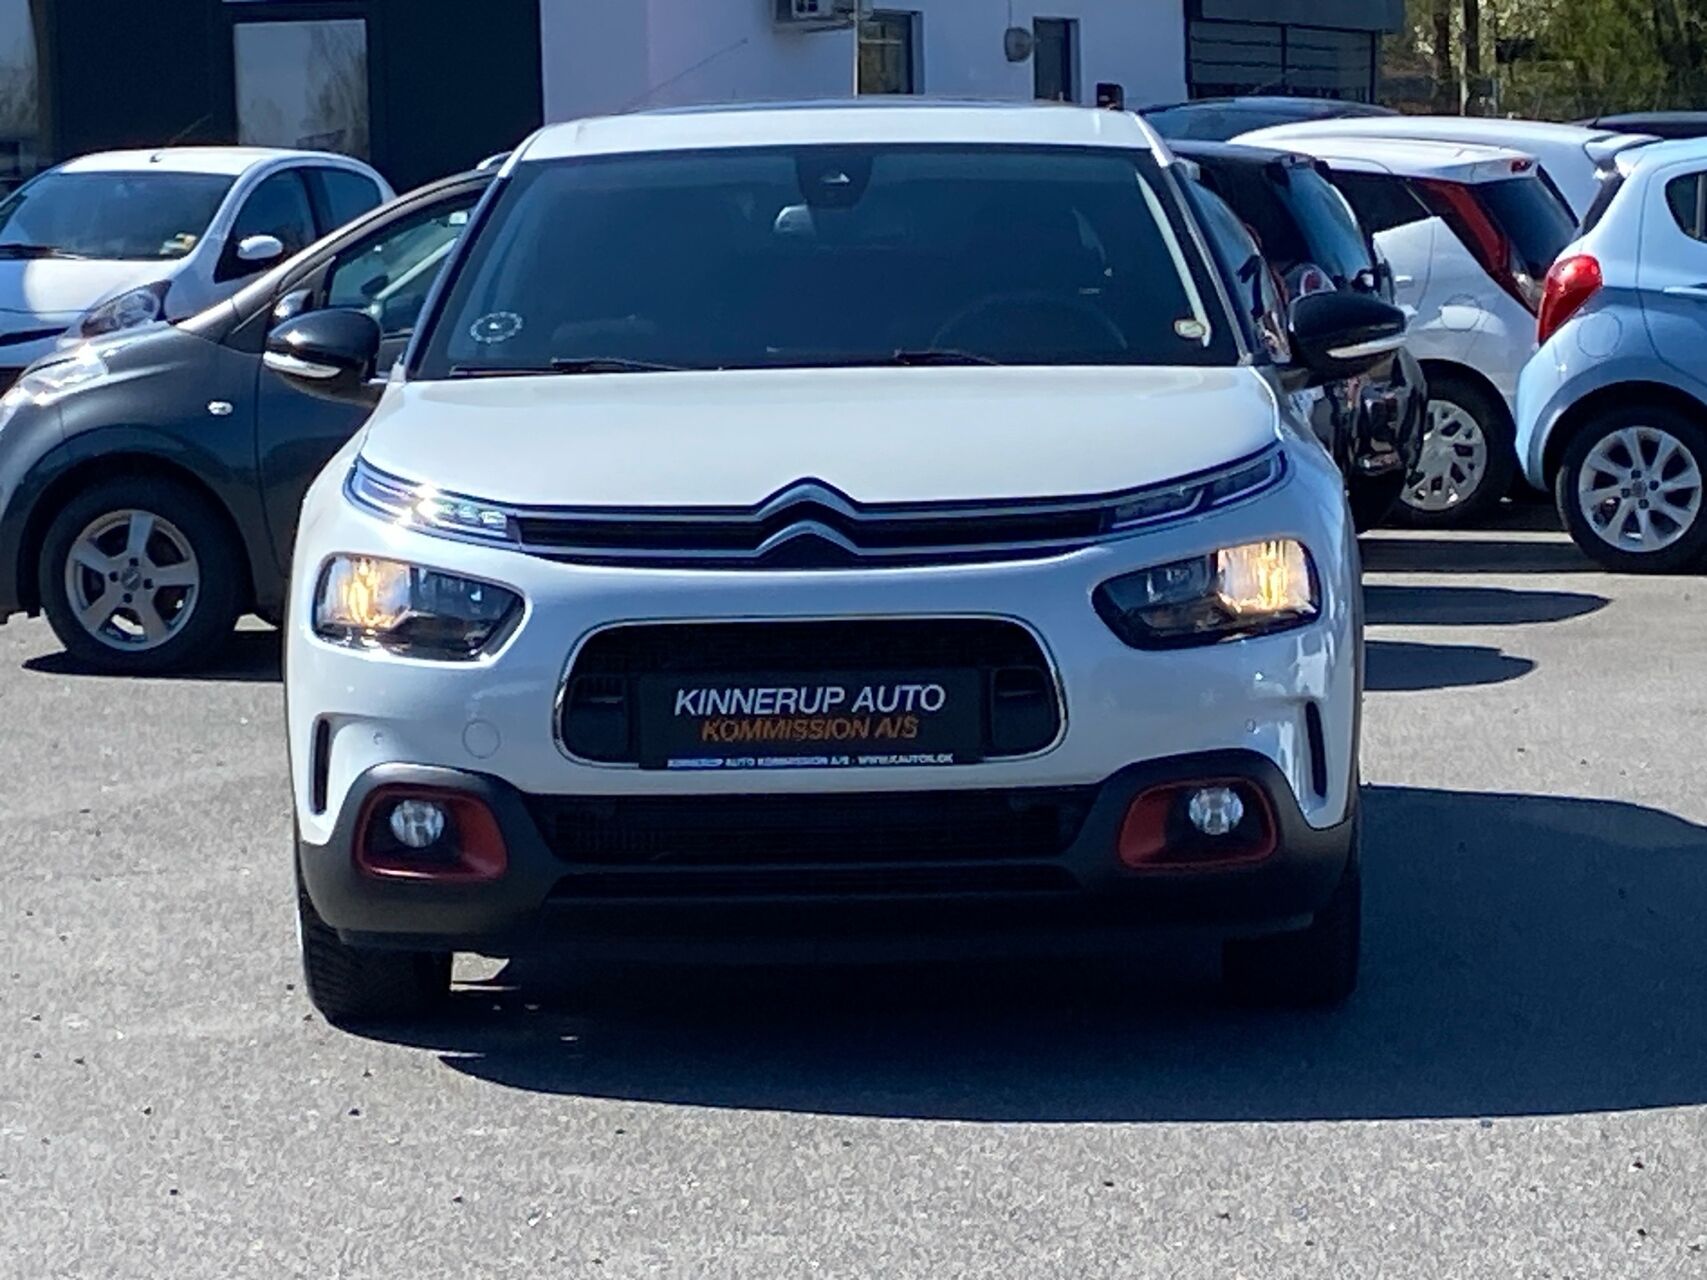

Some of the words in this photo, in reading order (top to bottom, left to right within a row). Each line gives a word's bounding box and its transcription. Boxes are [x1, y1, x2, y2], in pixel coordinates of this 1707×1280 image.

[674, 687, 845, 716] KINNERUP
[851, 684, 946, 713] AUTO
[702, 718, 870, 742] KOMMISSION
[874, 715, 919, 739] A/S
